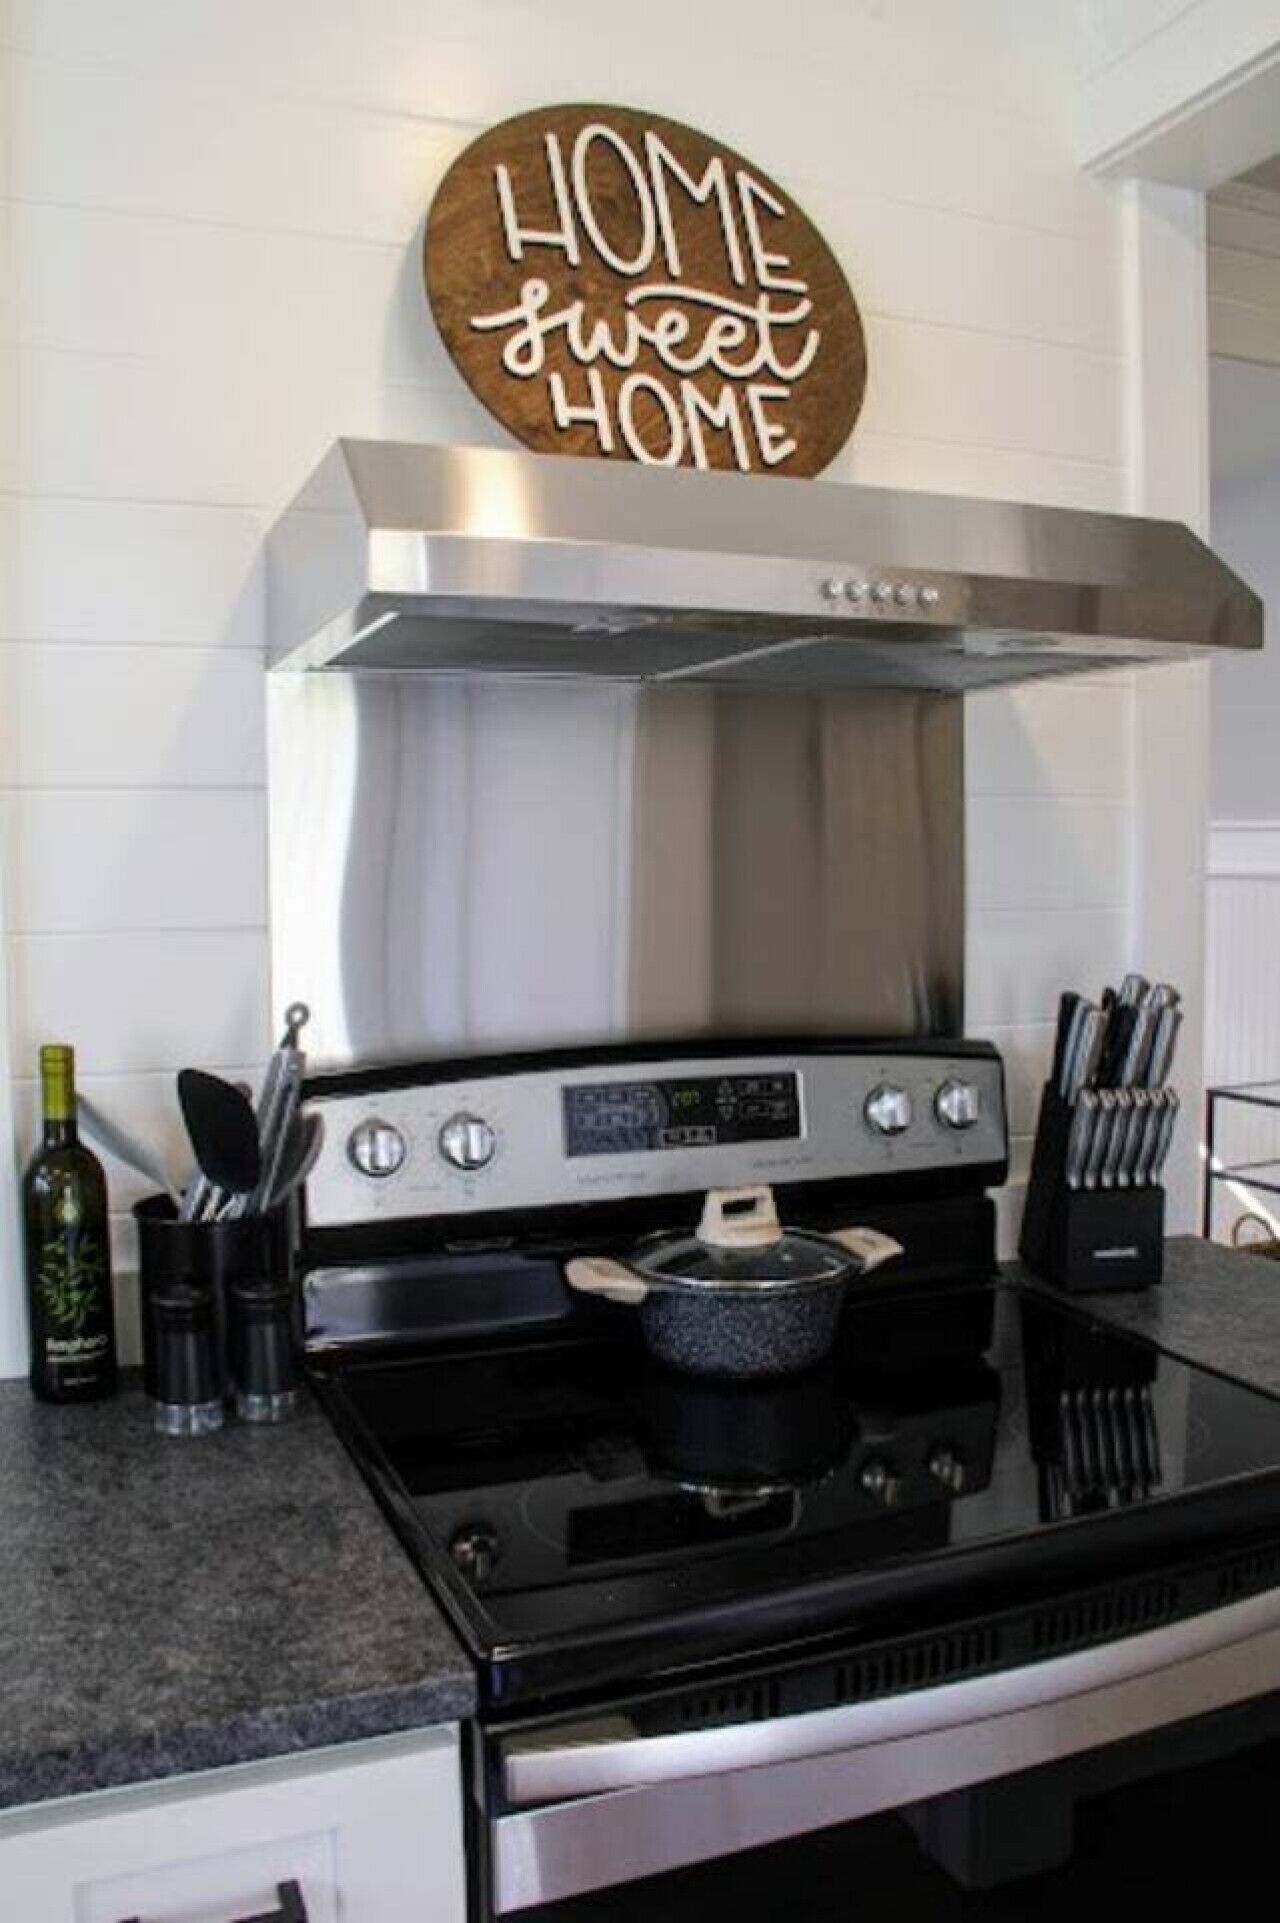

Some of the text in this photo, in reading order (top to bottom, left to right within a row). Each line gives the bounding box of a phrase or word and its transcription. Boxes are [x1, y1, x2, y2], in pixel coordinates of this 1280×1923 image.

[496, 123, 808, 292] HOME
[470, 278, 820, 381] sweet
[549, 367, 798, 471] HOME
